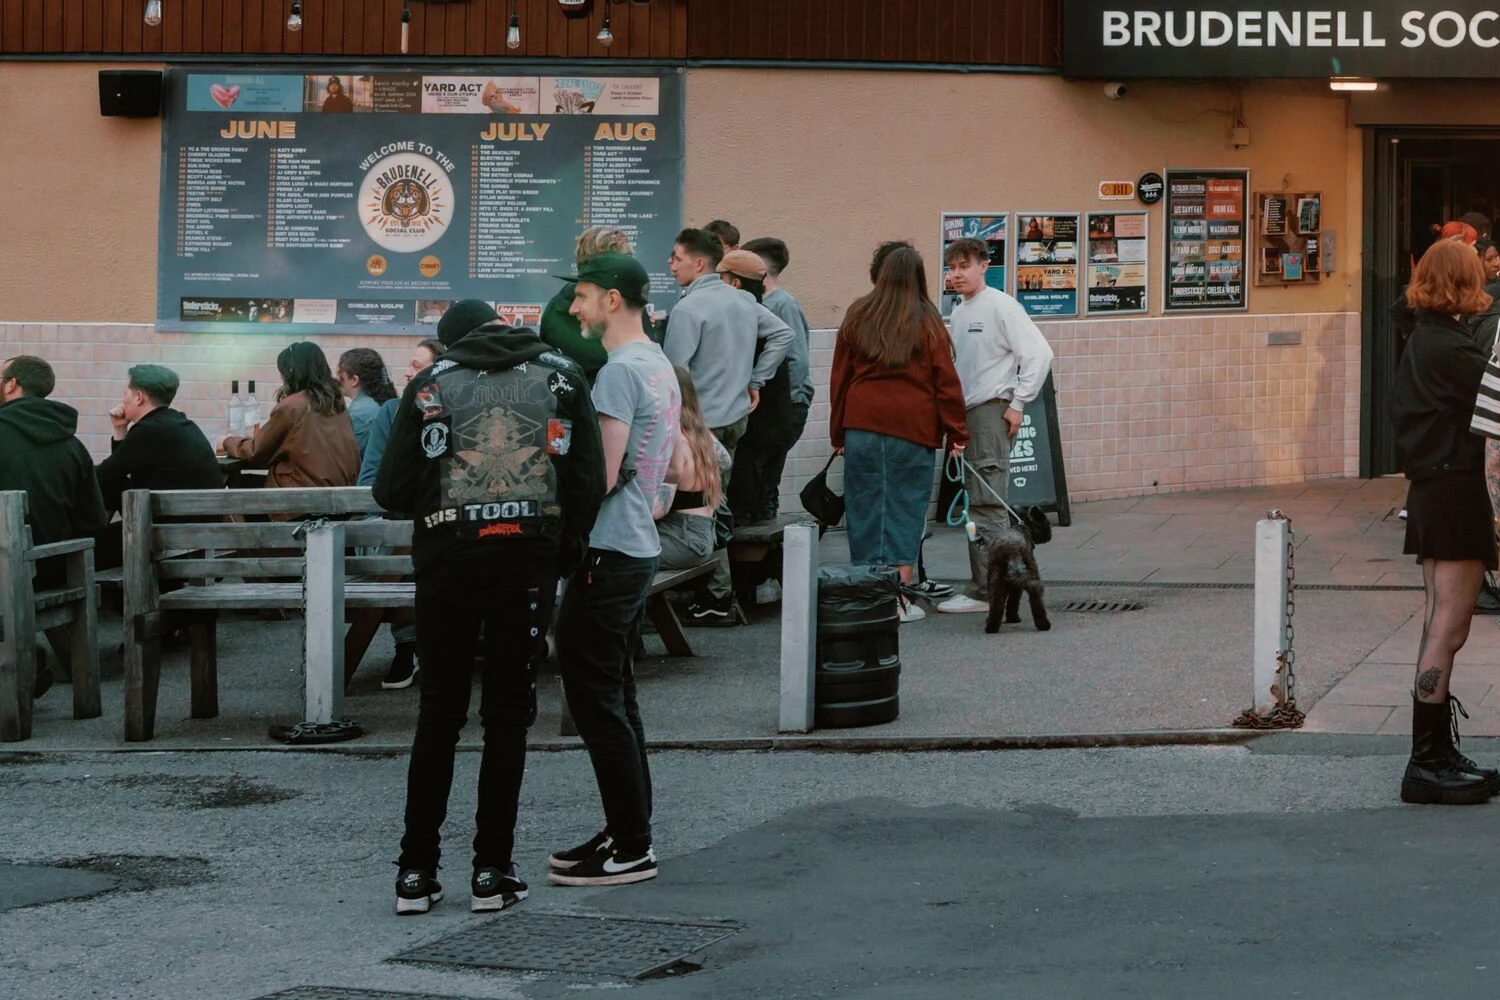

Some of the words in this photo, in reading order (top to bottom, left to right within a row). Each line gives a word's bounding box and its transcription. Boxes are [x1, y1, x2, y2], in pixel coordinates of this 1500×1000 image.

[1102, 11, 1386, 48] BRUDENELL
[424, 83, 456, 92] YARD
[460, 83, 483, 92] ACT
[220, 120, 297, 139] JUNE
[480, 122, 551, 141] JULY
[593, 122, 657, 141] AUG
[359, 141, 415, 172] WELCOME
[418, 143, 434, 155] TO
[435, 152, 456, 173] THE
[375, 164, 437, 190] BRUDENELL
[944, 218, 964, 231] BIKINI
[948, 228, 963, 239] KILL
[182, 300, 219, 311] tindersticks
[464, 501, 536, 521] TOOL
